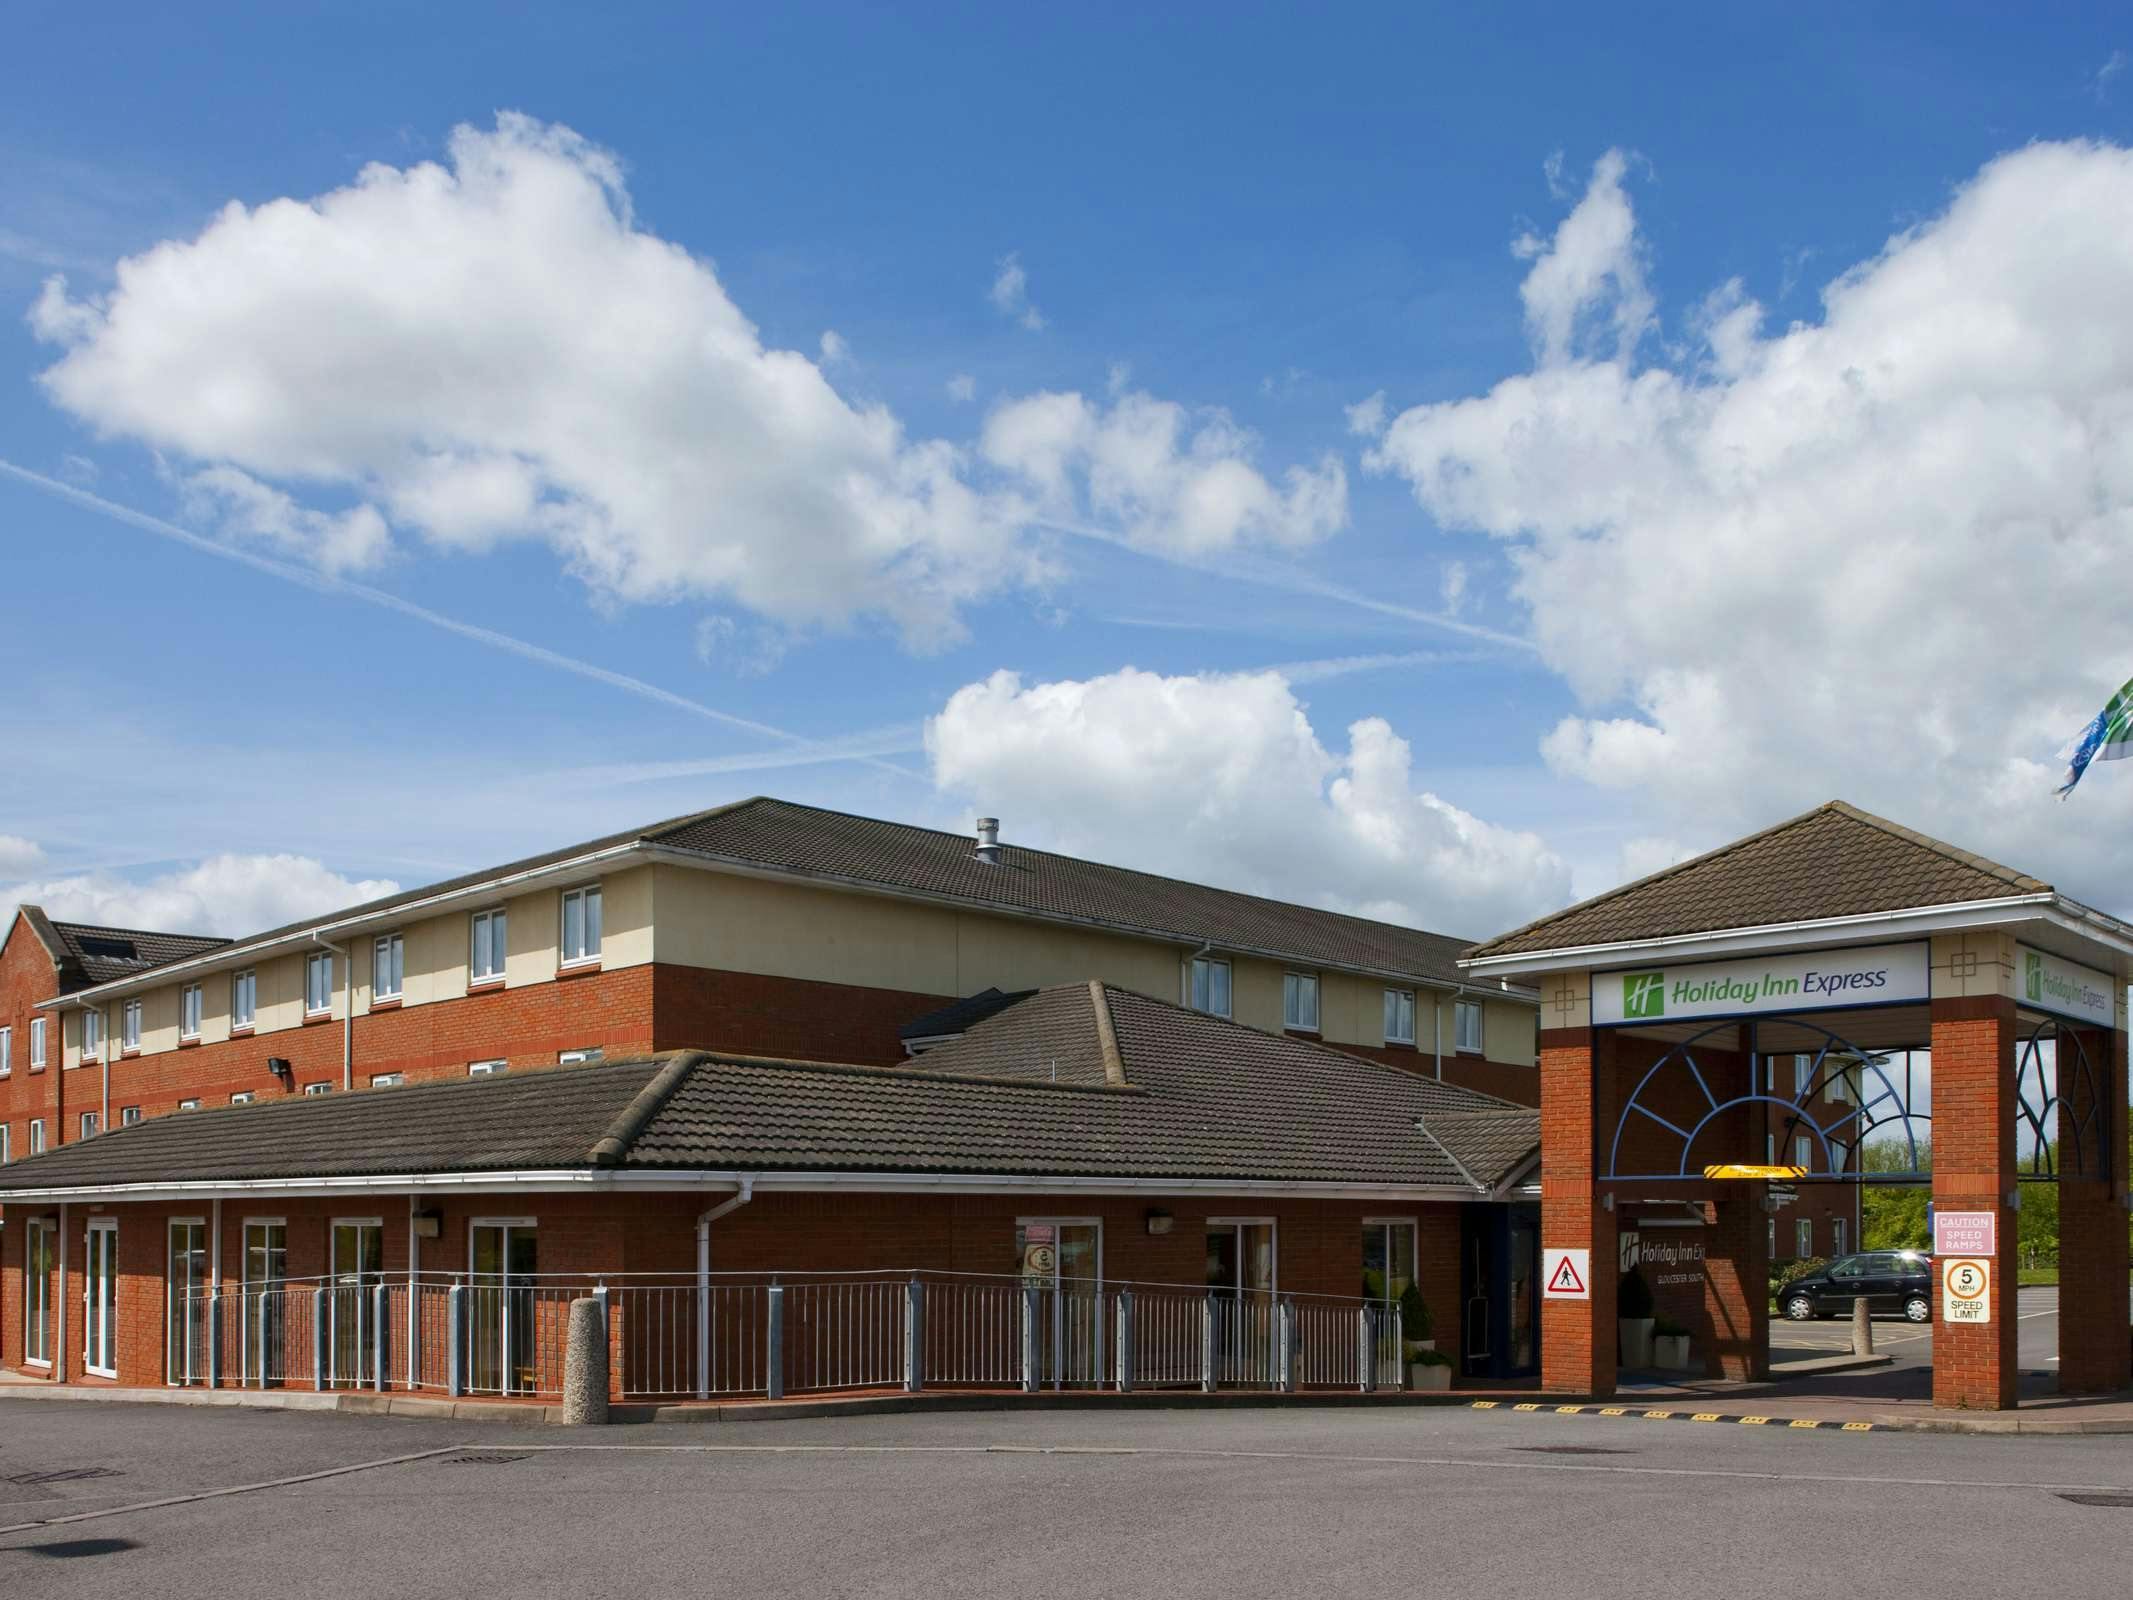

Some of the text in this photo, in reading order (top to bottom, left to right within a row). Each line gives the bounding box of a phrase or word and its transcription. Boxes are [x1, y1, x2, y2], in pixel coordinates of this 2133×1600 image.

[1672, 970, 1887, 1004] Holiday Inn Express
[2042, 970, 2071, 1005] Holiday
[1940, 1218, 1989, 1226] CAUTION
[1946, 1231, 1982, 1239] SPEED
[1945, 1241, 1983, 1249] RAMPS
[1641, 1241, 1678, 1266] Holiday
[1679, 1241, 1693, 1261] Inn
[1961, 1269, 1973, 1284] 5
[1951, 1300, 1983, 1310] SPEED
[1954, 1310, 1979, 1319] LIMIT
